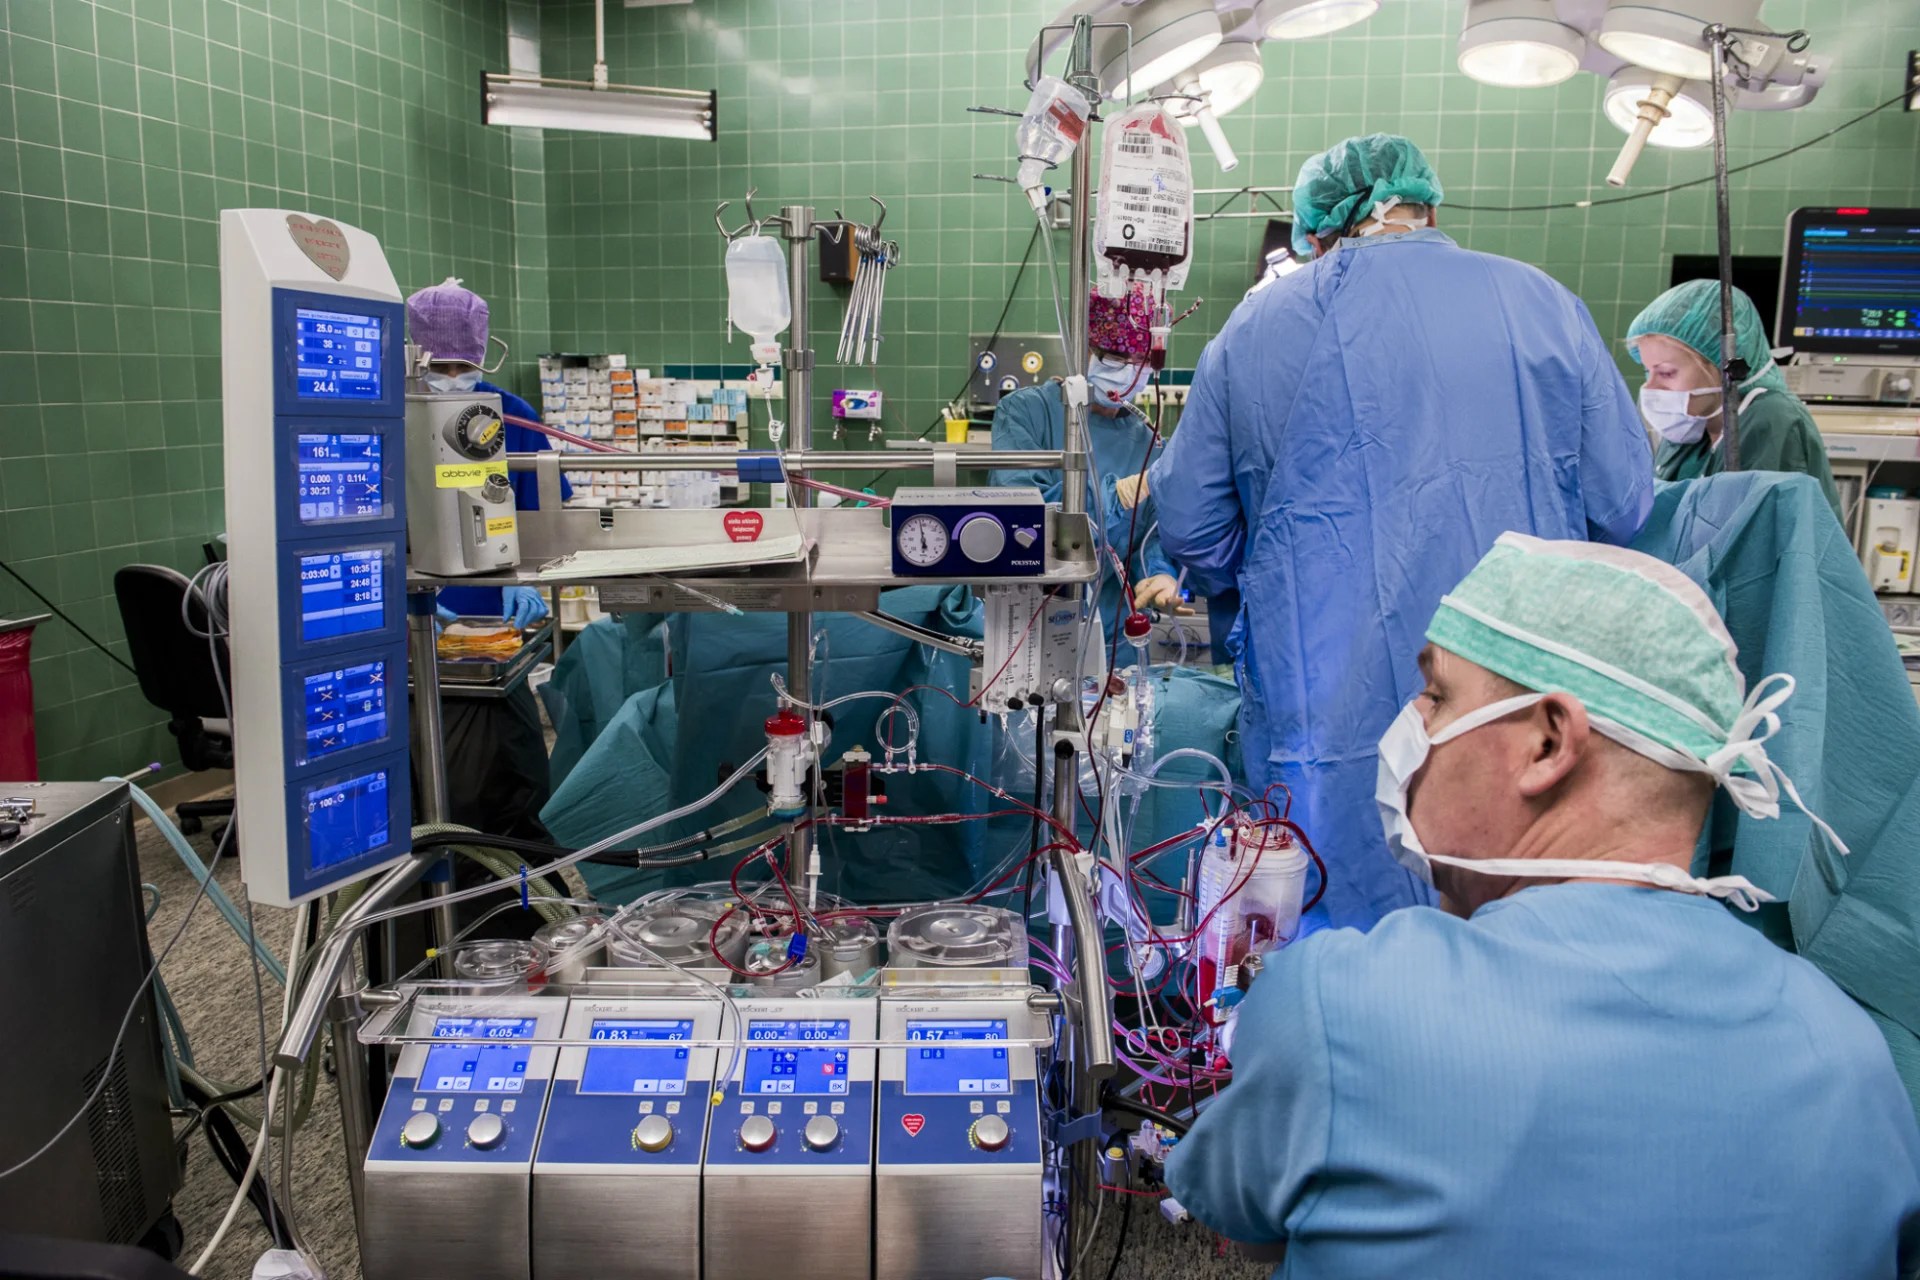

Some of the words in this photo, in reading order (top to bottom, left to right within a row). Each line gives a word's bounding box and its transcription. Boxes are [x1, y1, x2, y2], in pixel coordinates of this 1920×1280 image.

[1122, 223, 1136, 240] O
[316, 323, 333, 333] 25.0
[323, 339, 333, 348] 38
[327, 355, 333, 364] 2
[313, 381, 334, 392] 24.4
[313, 447, 329, 457] 161
[310, 475, 331, 483] 0.000
[347, 474, 366, 482] 0.114
[441, 469, 481, 478] abbvie
[310, 487, 331, 496] 30:21
[301, 569, 329, 580] 0:03:00
[350, 564, 370, 574] 10:35
[350, 578, 370, 589] 24:48
[355, 591, 371, 601] 8:18
[319, 797, 333, 808] 100
[440, 1027, 463, 1037] 0.34
[489, 1028, 513, 1037] 0.05
[596, 1030, 628, 1040] 083
[754, 1030, 778, 1040] 0.00
[804, 1030, 828, 1040] 0.00
[912, 1030, 943, 1040] 057
